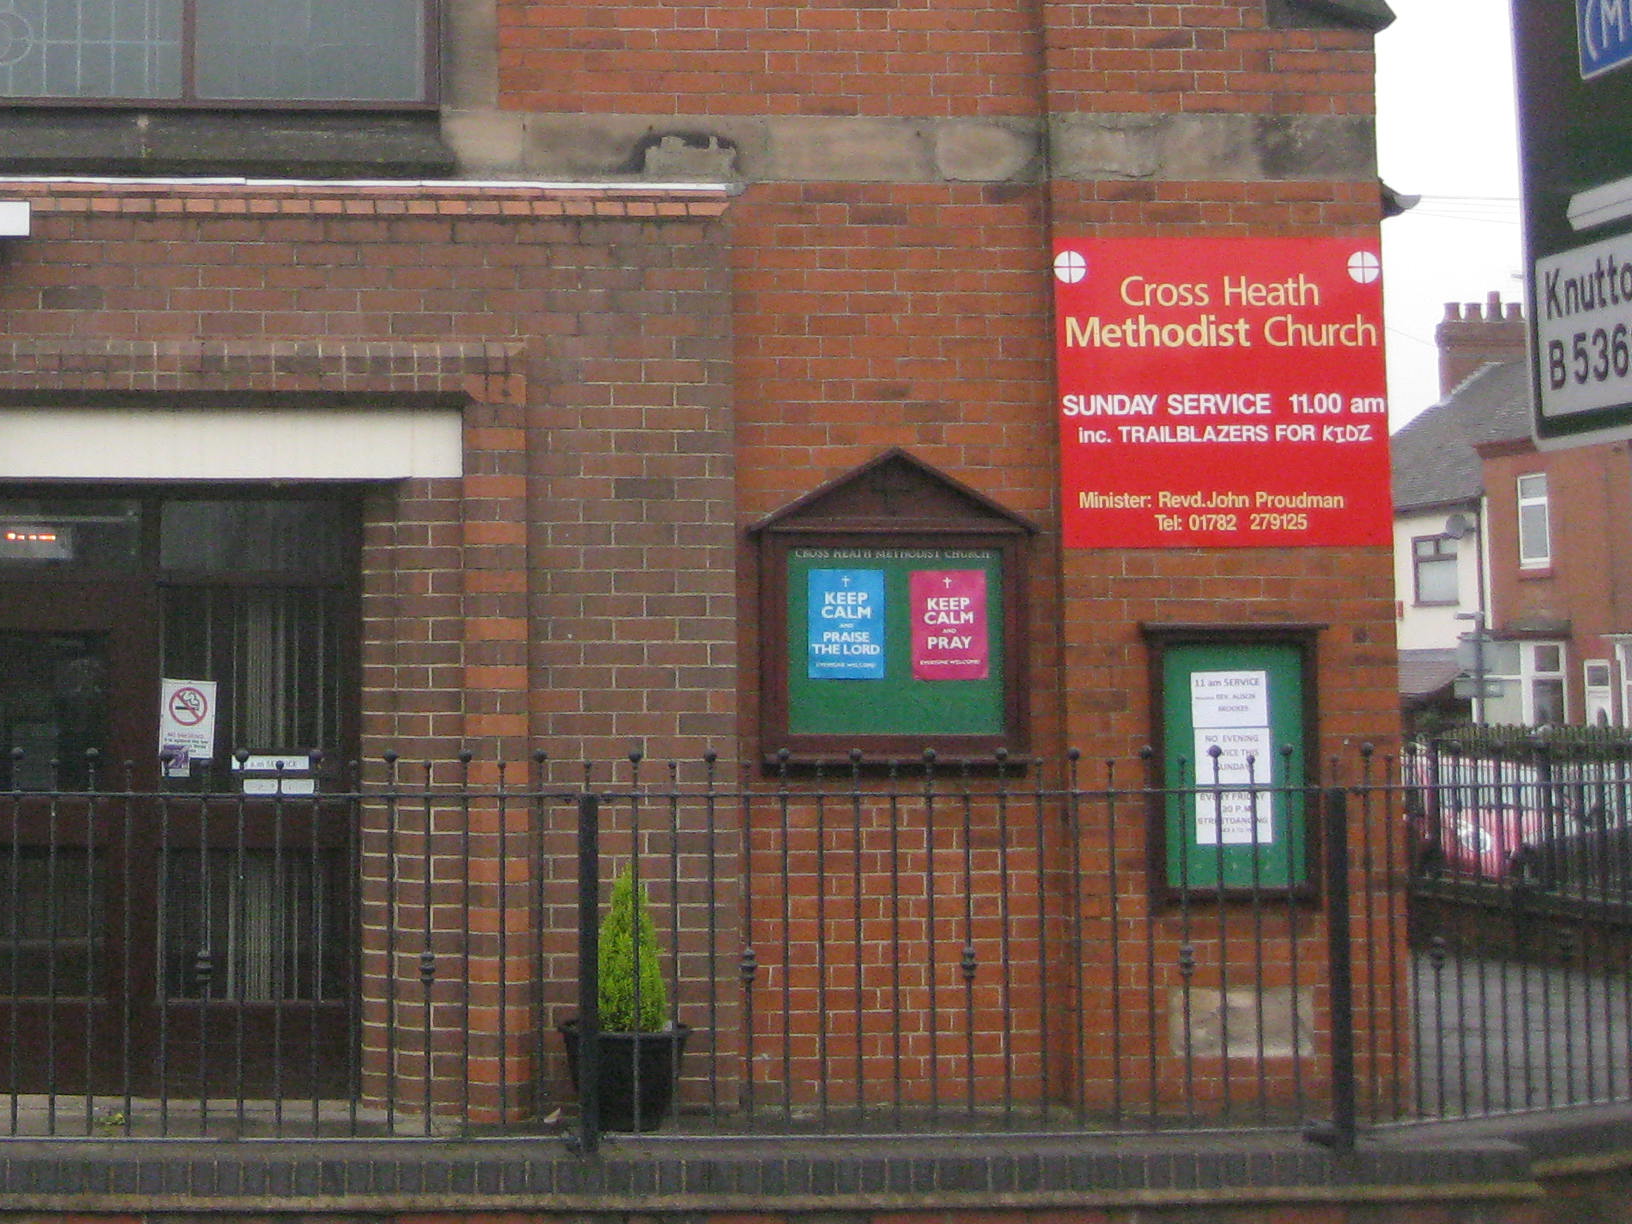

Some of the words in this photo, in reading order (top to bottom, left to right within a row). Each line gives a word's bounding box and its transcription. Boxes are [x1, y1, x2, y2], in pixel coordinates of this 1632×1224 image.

[1120, 275, 1210, 307] Cross
[1223, 273, 1320, 307] Heath
[1065, 313, 1252, 348] Methodist
[1263, 313, 1377, 347] Church
[1062, 394, 1158, 416] SUNDAY
[1167, 393, 1272, 415] SERVICE
[1288, 393, 1343, 414] 11.00
[1350, 397, 1385, 414] am
[1078, 426, 1112, 444] inc.
[1118, 425, 1268, 443] TRAILBLAZERS
[1274, 424, 1316, 442] FOR
[1322, 423, 1373, 443] KIDZ
[1078, 491, 1152, 509] Minister:
[1255, 491, 1345, 509] Proudman
[1154, 514, 1183, 531] Tel:
[1188, 514, 1237, 531] 01782
[1249, 513, 1308, 530] 279125
[824, 591, 868, 605] KEEP
[926, 597, 970, 611] KEEP
[821, 605, 871, 619] CALM
[923, 611, 974, 625] CALM
[823, 631, 870, 643] PRAISE
[927, 636, 972, 650] PRAY
[812, 643, 841, 655] THE
[843, 644, 881, 655] LORD
[1194, 679, 1205, 687] 11
[1223, 678, 1259, 687] SERVICE
[1204, 735, 1218, 743] NO
[1222, 735, 1259, 743] EVENING
